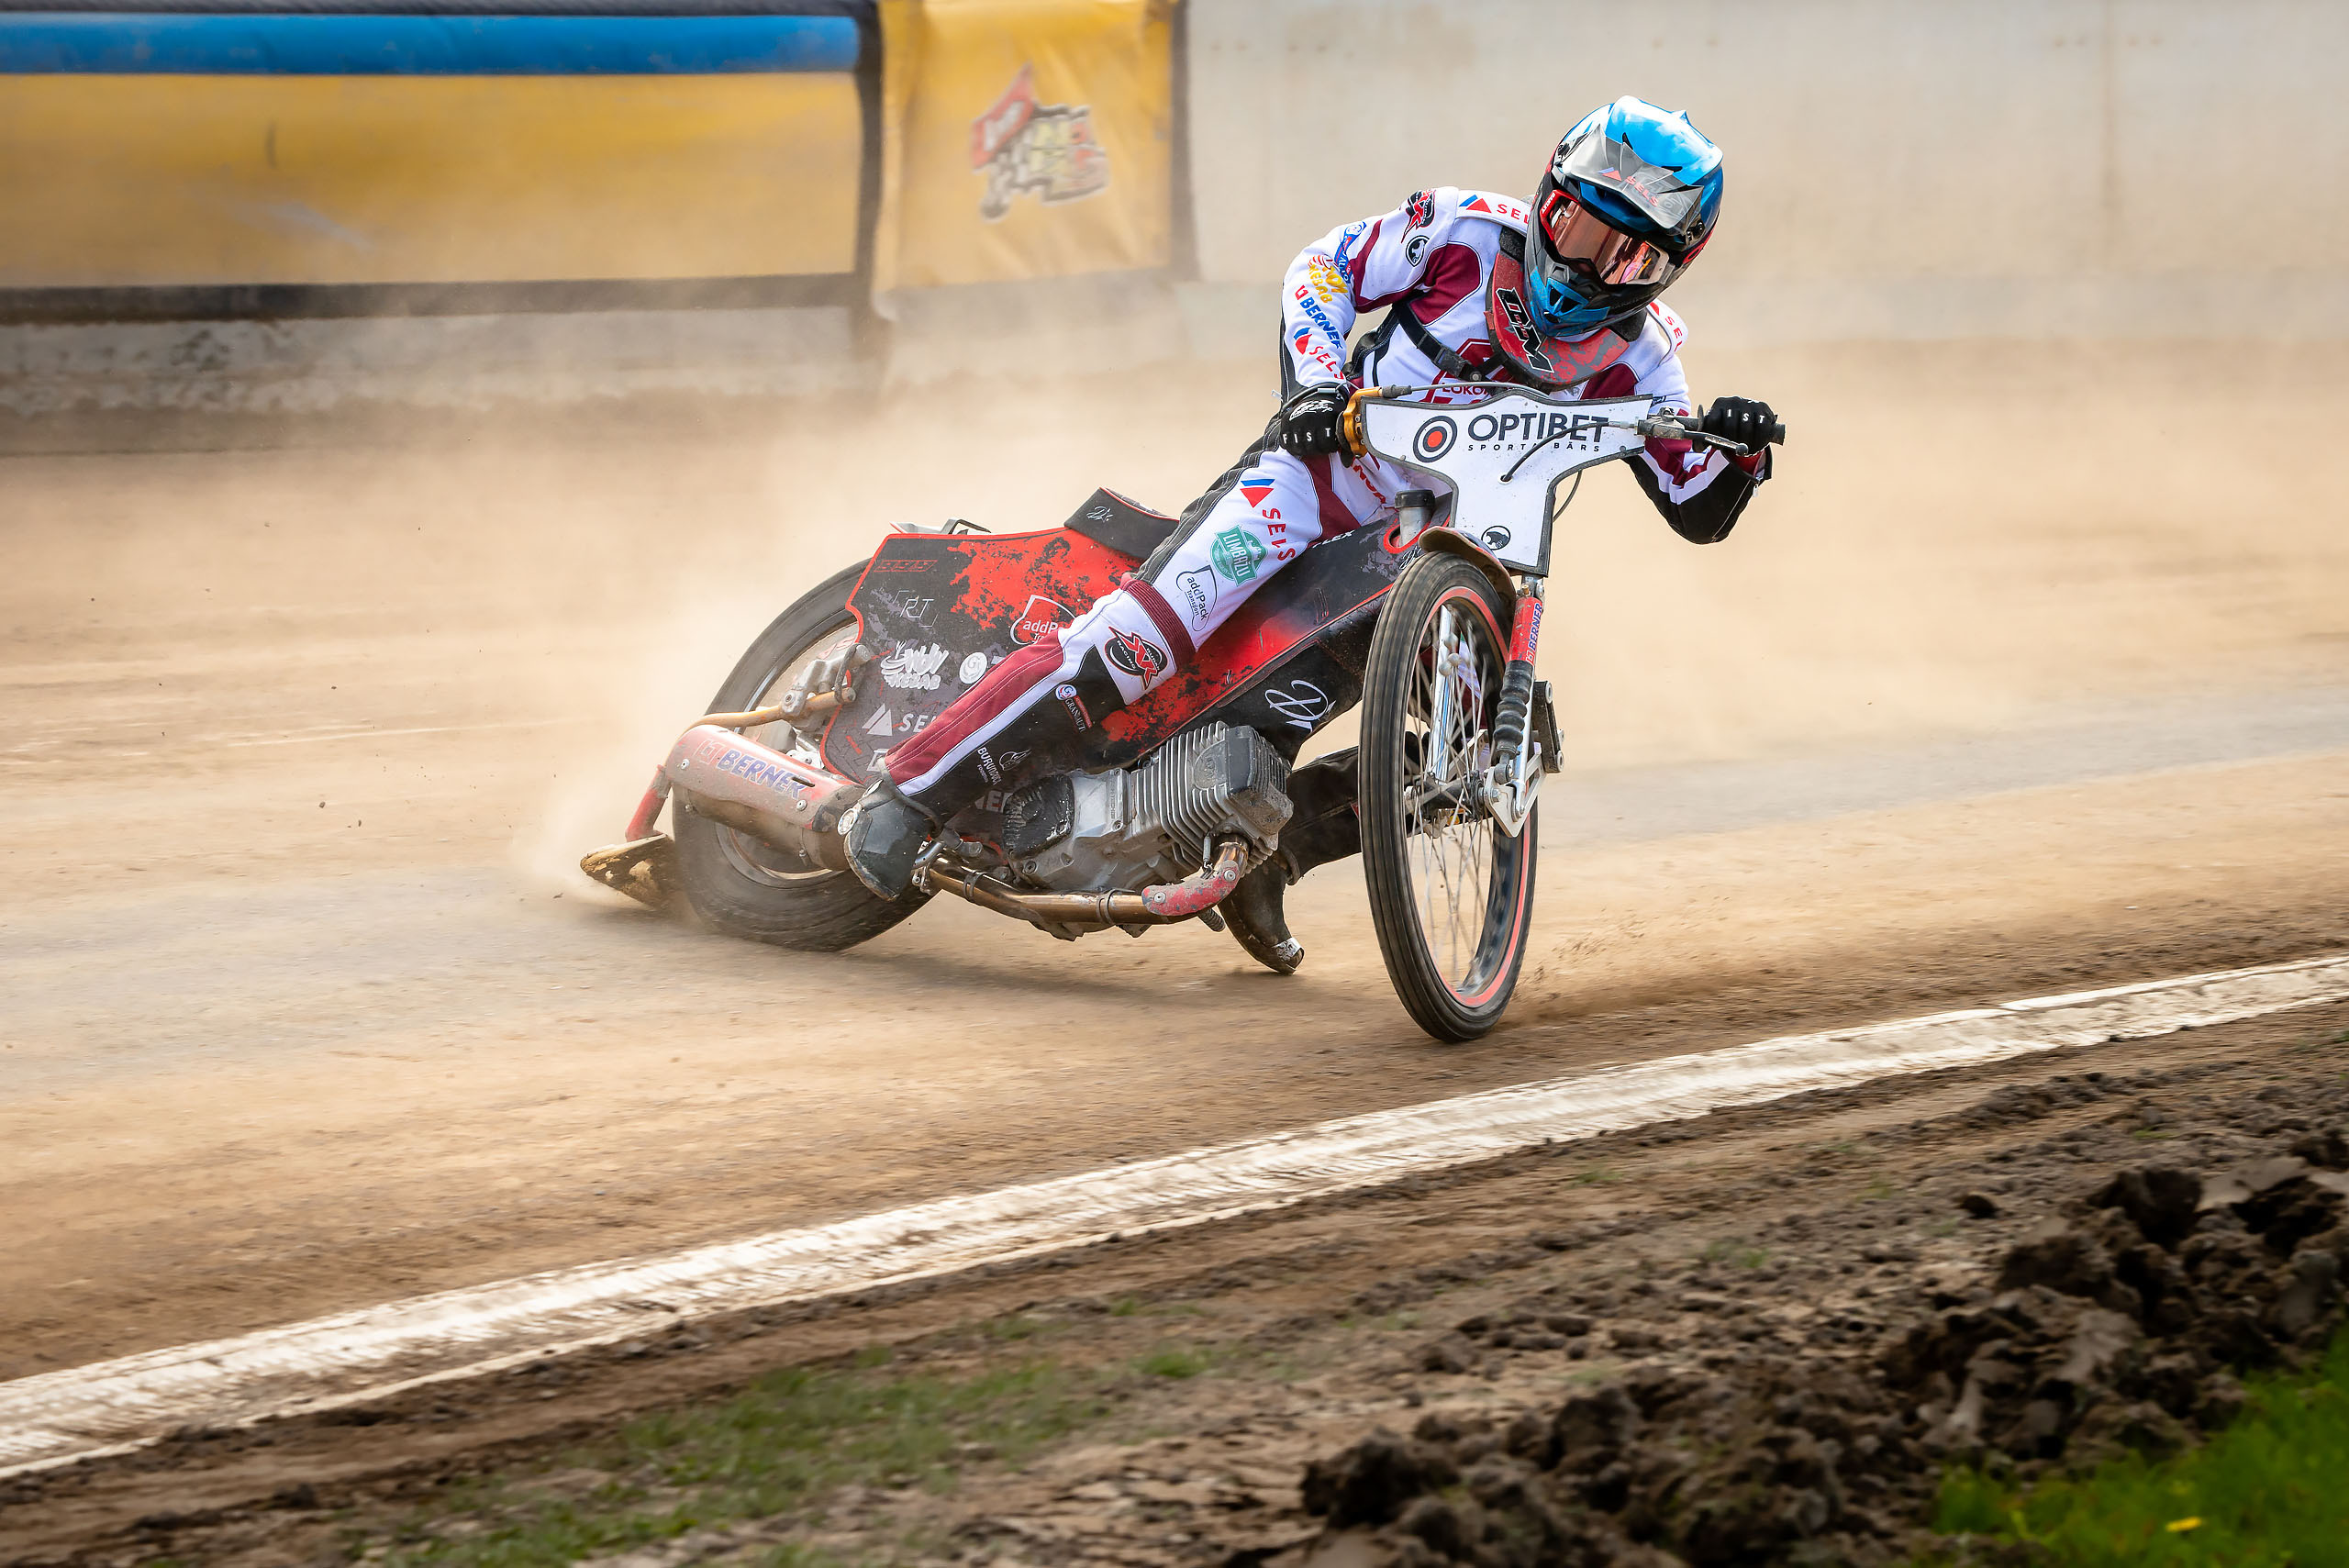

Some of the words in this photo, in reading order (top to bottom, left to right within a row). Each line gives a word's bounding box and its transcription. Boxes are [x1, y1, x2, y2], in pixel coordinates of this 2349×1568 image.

[1624, 175, 1659, 207] SELS
[1496, 203, 1530, 225] SEL
[1308, 263, 1333, 304] KEBAB
[1467, 412, 1609, 443] OPTIBET
[1727, 408, 1765, 424] IST
[1282, 428, 1331, 444] FIST
[1553, 440, 1600, 452] BĀRS
[1262, 507, 1296, 562] SELS
[1222, 533, 1251, 578] LIMBAŽU
[1186, 576, 1209, 621] addPack
[1022, 619, 1059, 634] addP
[1527, 602, 1542, 651] BERNER
[1116, 639, 1137, 670] RACING
[717, 748, 812, 801] BERNER
